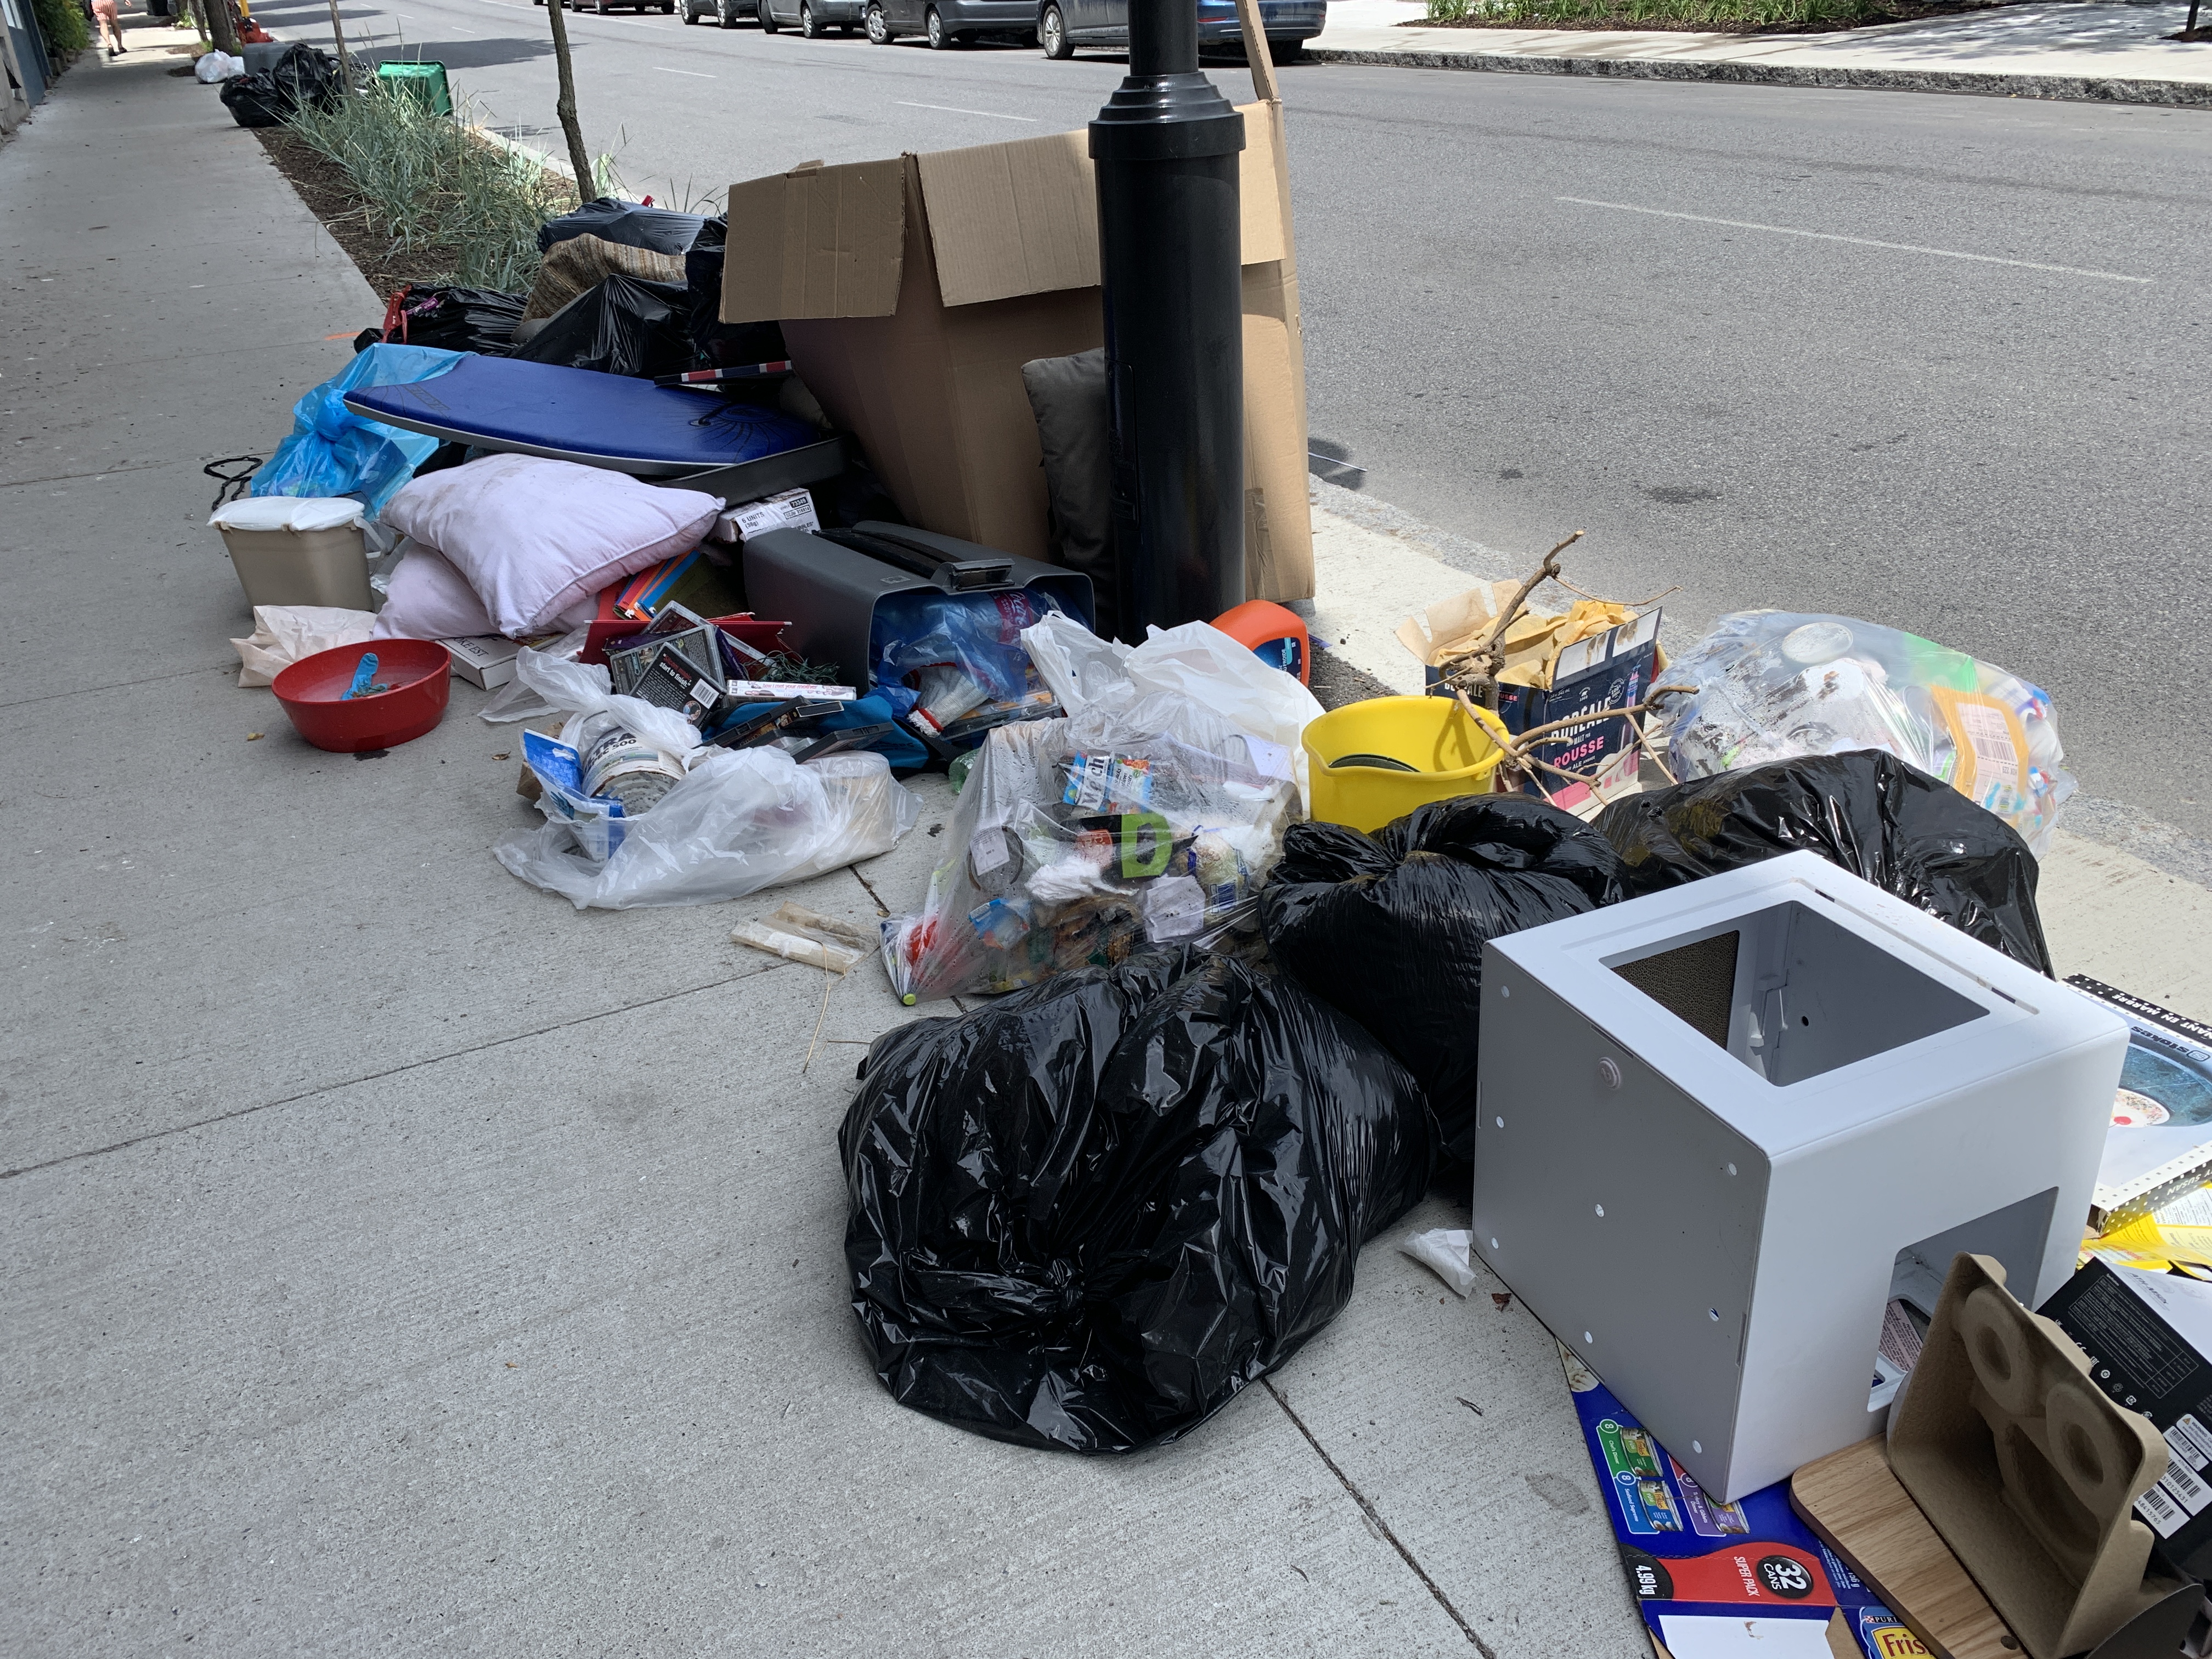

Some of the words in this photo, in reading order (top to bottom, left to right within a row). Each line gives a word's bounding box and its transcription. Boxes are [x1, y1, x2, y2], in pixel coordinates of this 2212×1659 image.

[791, 498, 806, 507] 73349
[747, 512, 764, 521] UNITS
[454, 637, 474, 648] OKE
[469, 646, 489, 656] EST
[659, 662, 670, 673] start
[1499, 692, 1517, 701] USSE
[612, 739, 636, 750] 500
[1554, 736, 1604, 769] ROUSSE
[1572, 761, 1582, 770] ALE
[2112, 994, 2161, 1015] MARBRE
[2160, 1014, 2180, 1023] EN
[2130, 1026, 2190, 1053] stokes
[2167, 1173, 2202, 1195] SUSAN
[1624, 1488, 1634, 1505] Seafood
[1629, 1504, 1639, 1522] Supreme
[1635, 1565, 1654, 1584] 4.99
[1734, 1556, 1750, 1577] SUPER
[1742, 1577, 1760, 1597] PACK
[1763, 1563, 1782, 1590] CANS
[1775, 1563, 1807, 1590] 32
[1882, 1633, 1927, 1657] Fris
